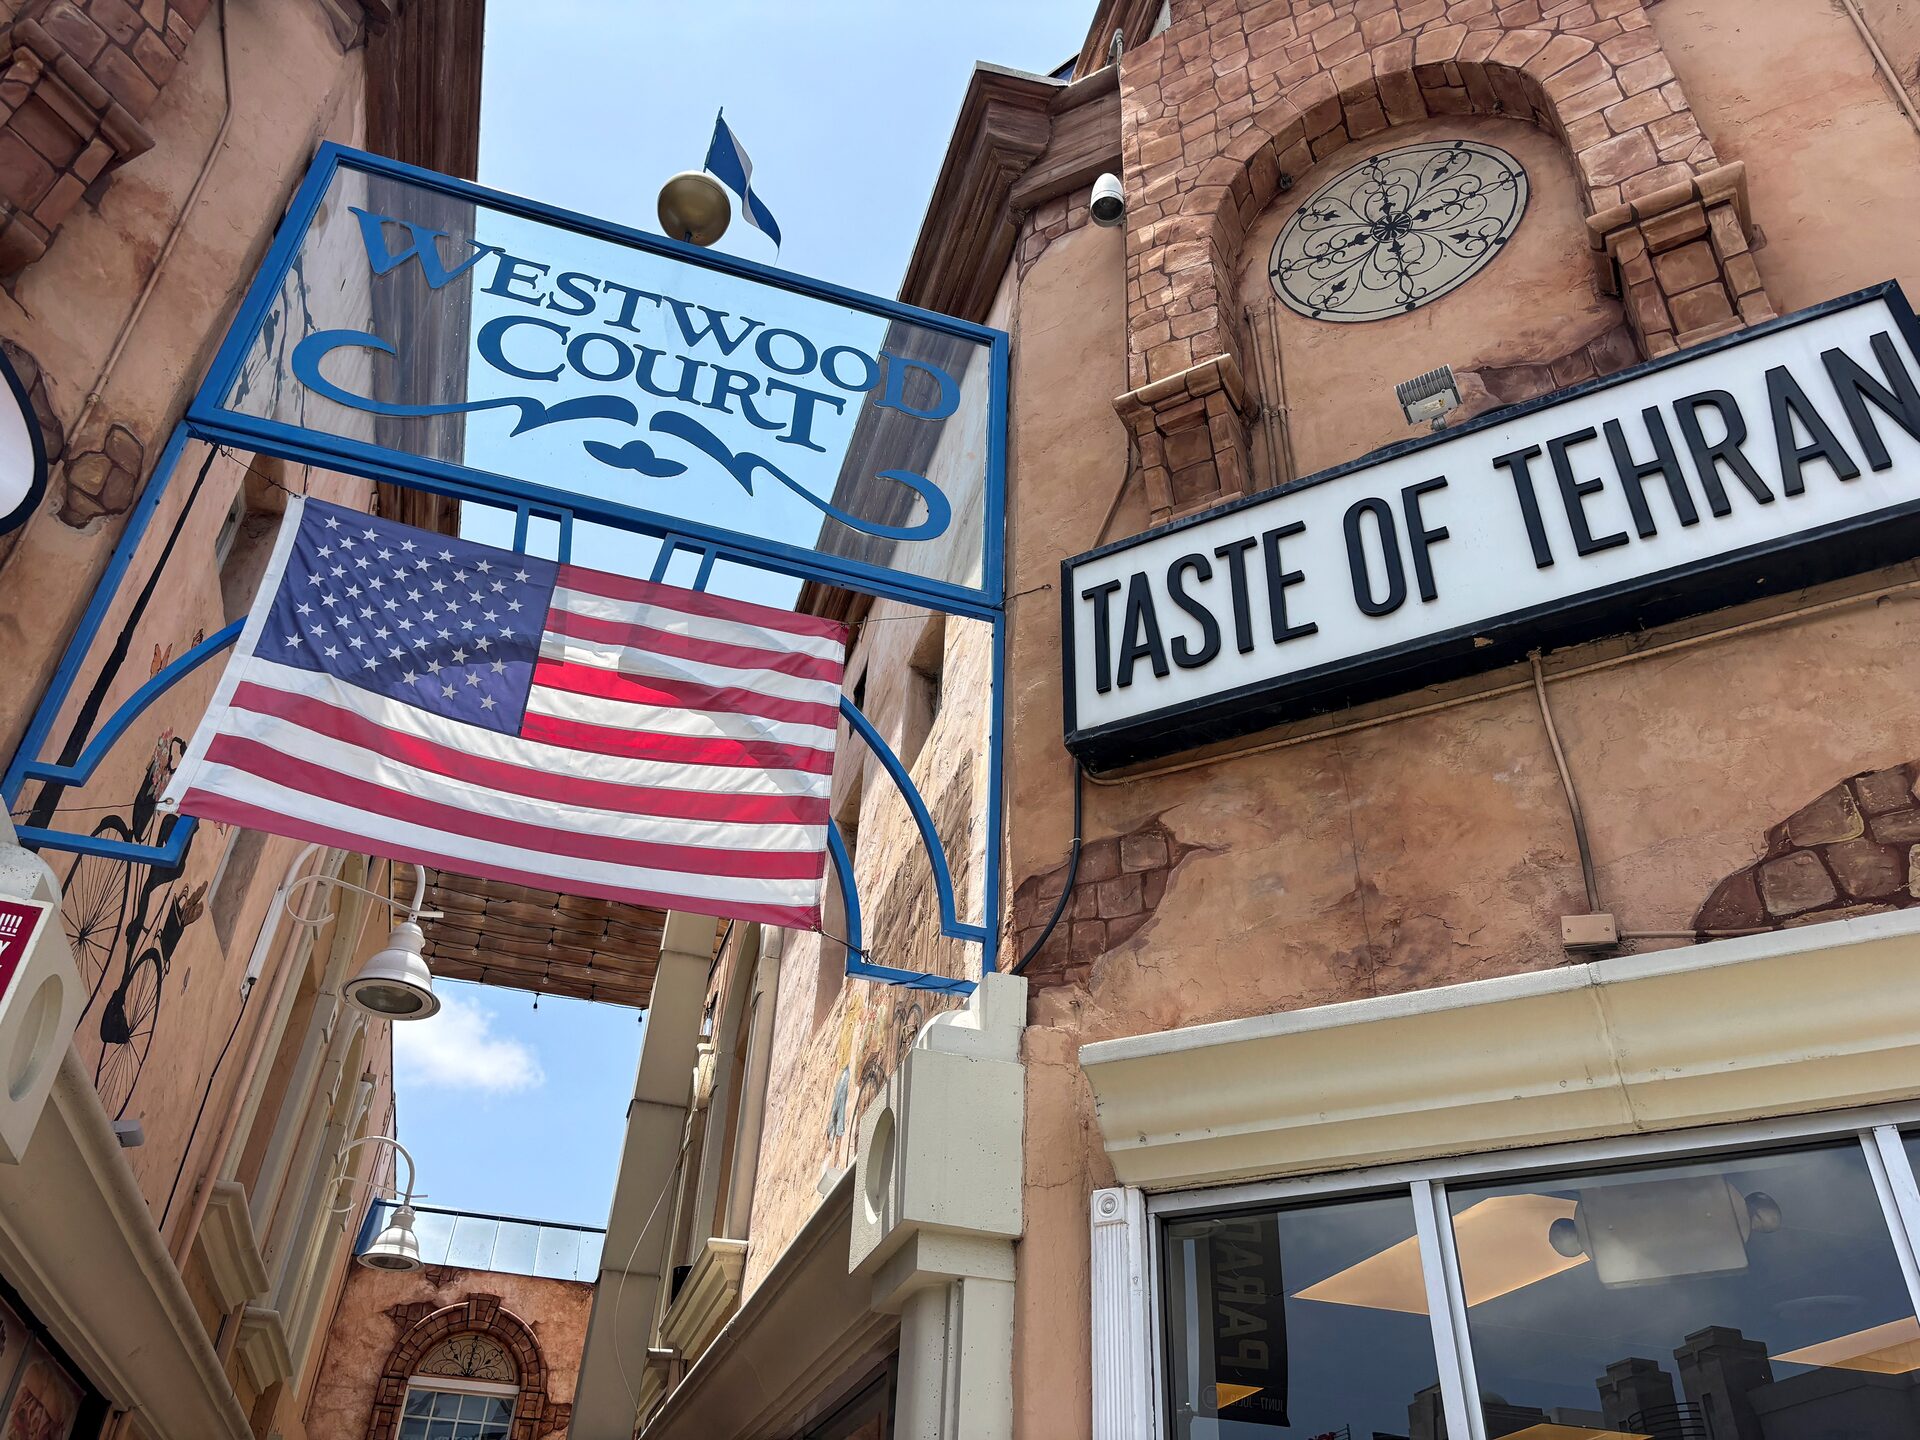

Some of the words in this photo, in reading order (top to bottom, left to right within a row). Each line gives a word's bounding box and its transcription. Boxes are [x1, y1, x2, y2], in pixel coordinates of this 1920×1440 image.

[347, 205, 961, 420] WESTWOOD
[477, 314, 847, 453] COURT
[1081, 520, 1318, 693] TASTE
[1342, 475, 1449, 617] OF
[1492, 330, 1920, 568] TEHRAN
